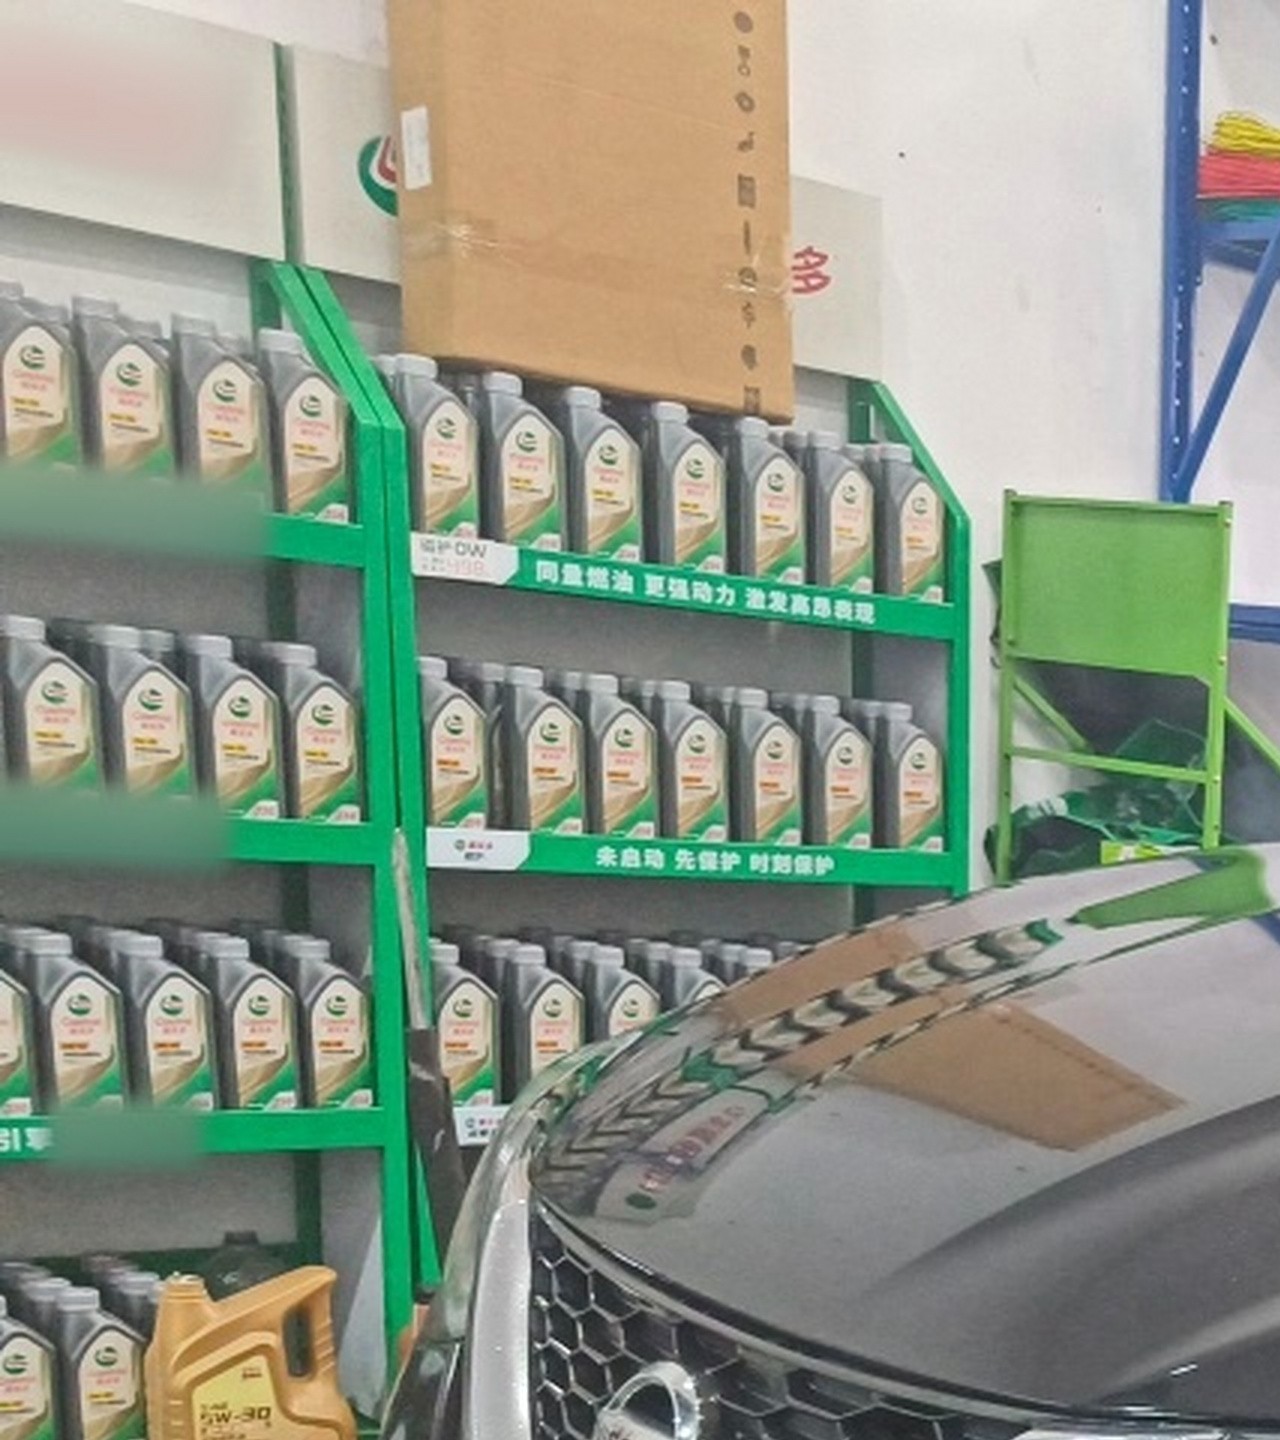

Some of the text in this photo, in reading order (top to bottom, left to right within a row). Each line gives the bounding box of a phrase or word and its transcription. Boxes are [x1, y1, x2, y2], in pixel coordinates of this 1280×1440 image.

[792, 245, 831, 294] 多
[644, 573, 736, 607] 更强动力
[597, 845, 835, 876] 未启动 先保护 时刻保护
